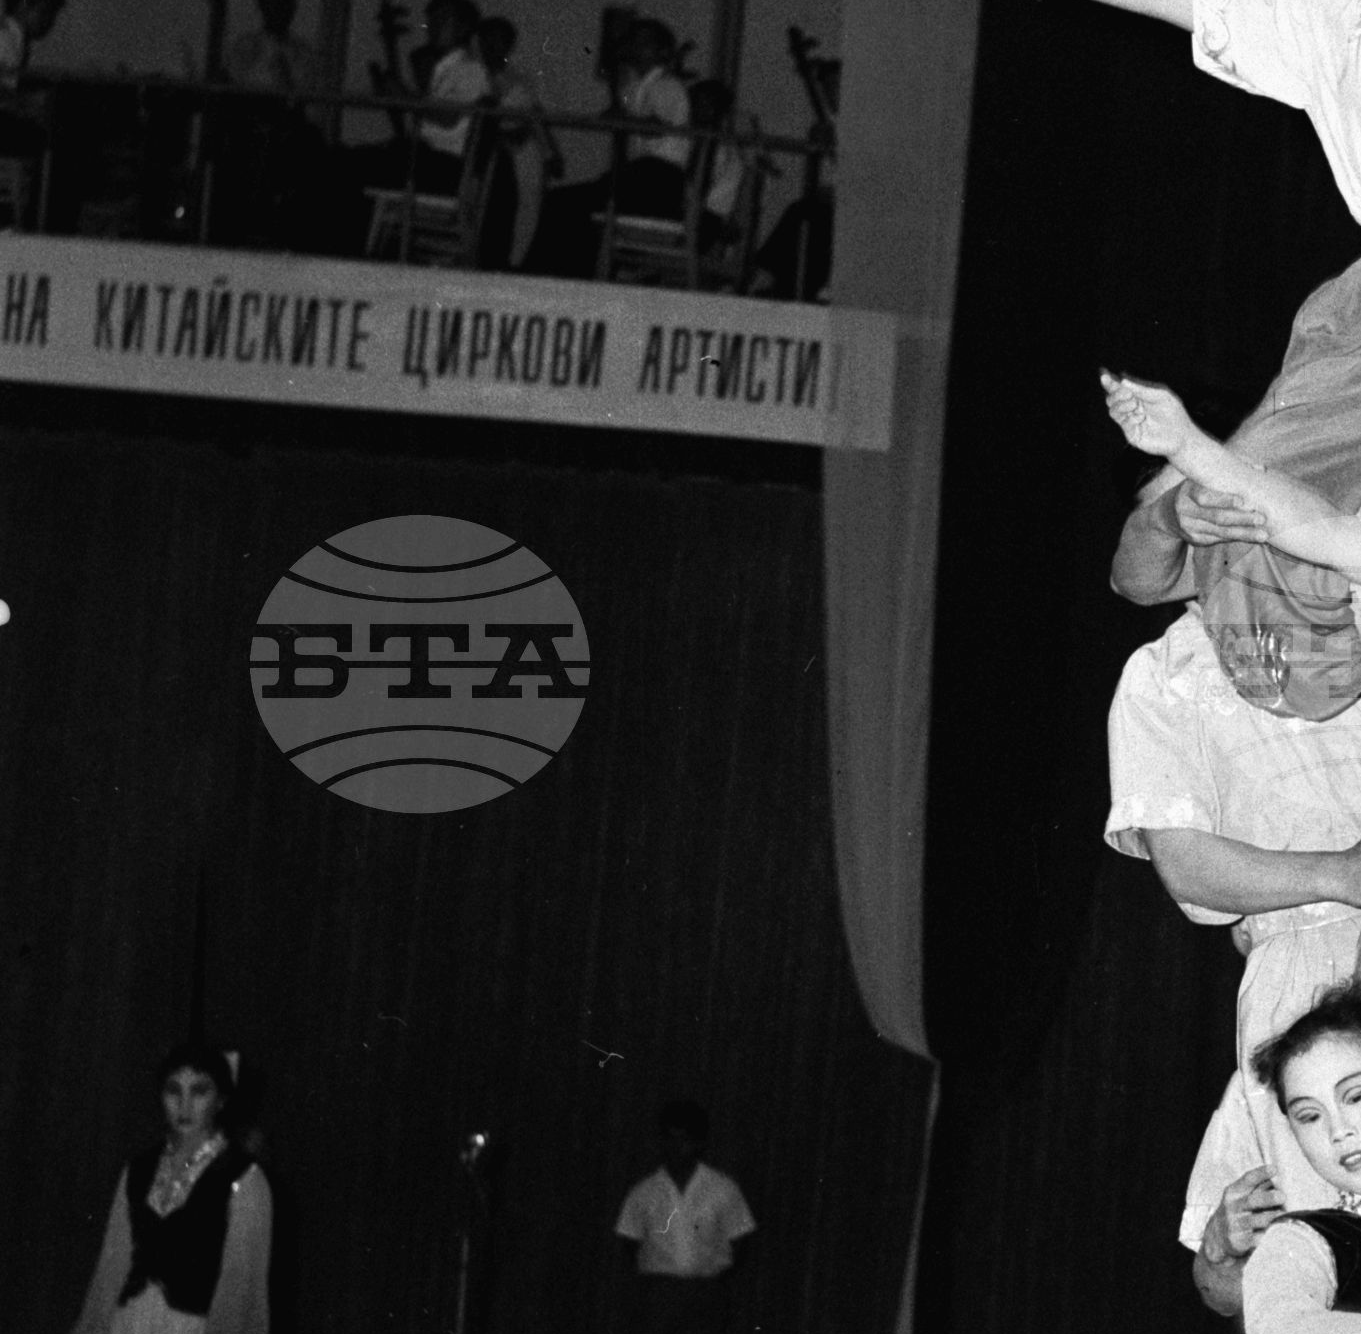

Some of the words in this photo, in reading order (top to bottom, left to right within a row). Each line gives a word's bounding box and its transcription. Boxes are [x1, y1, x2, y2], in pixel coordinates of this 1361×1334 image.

[1, 272, 51, 347] НА
[94, 273, 372, 372] КИТАЙСКИТЕ
[402, 305, 607, 389] ЦИРКОВИ
